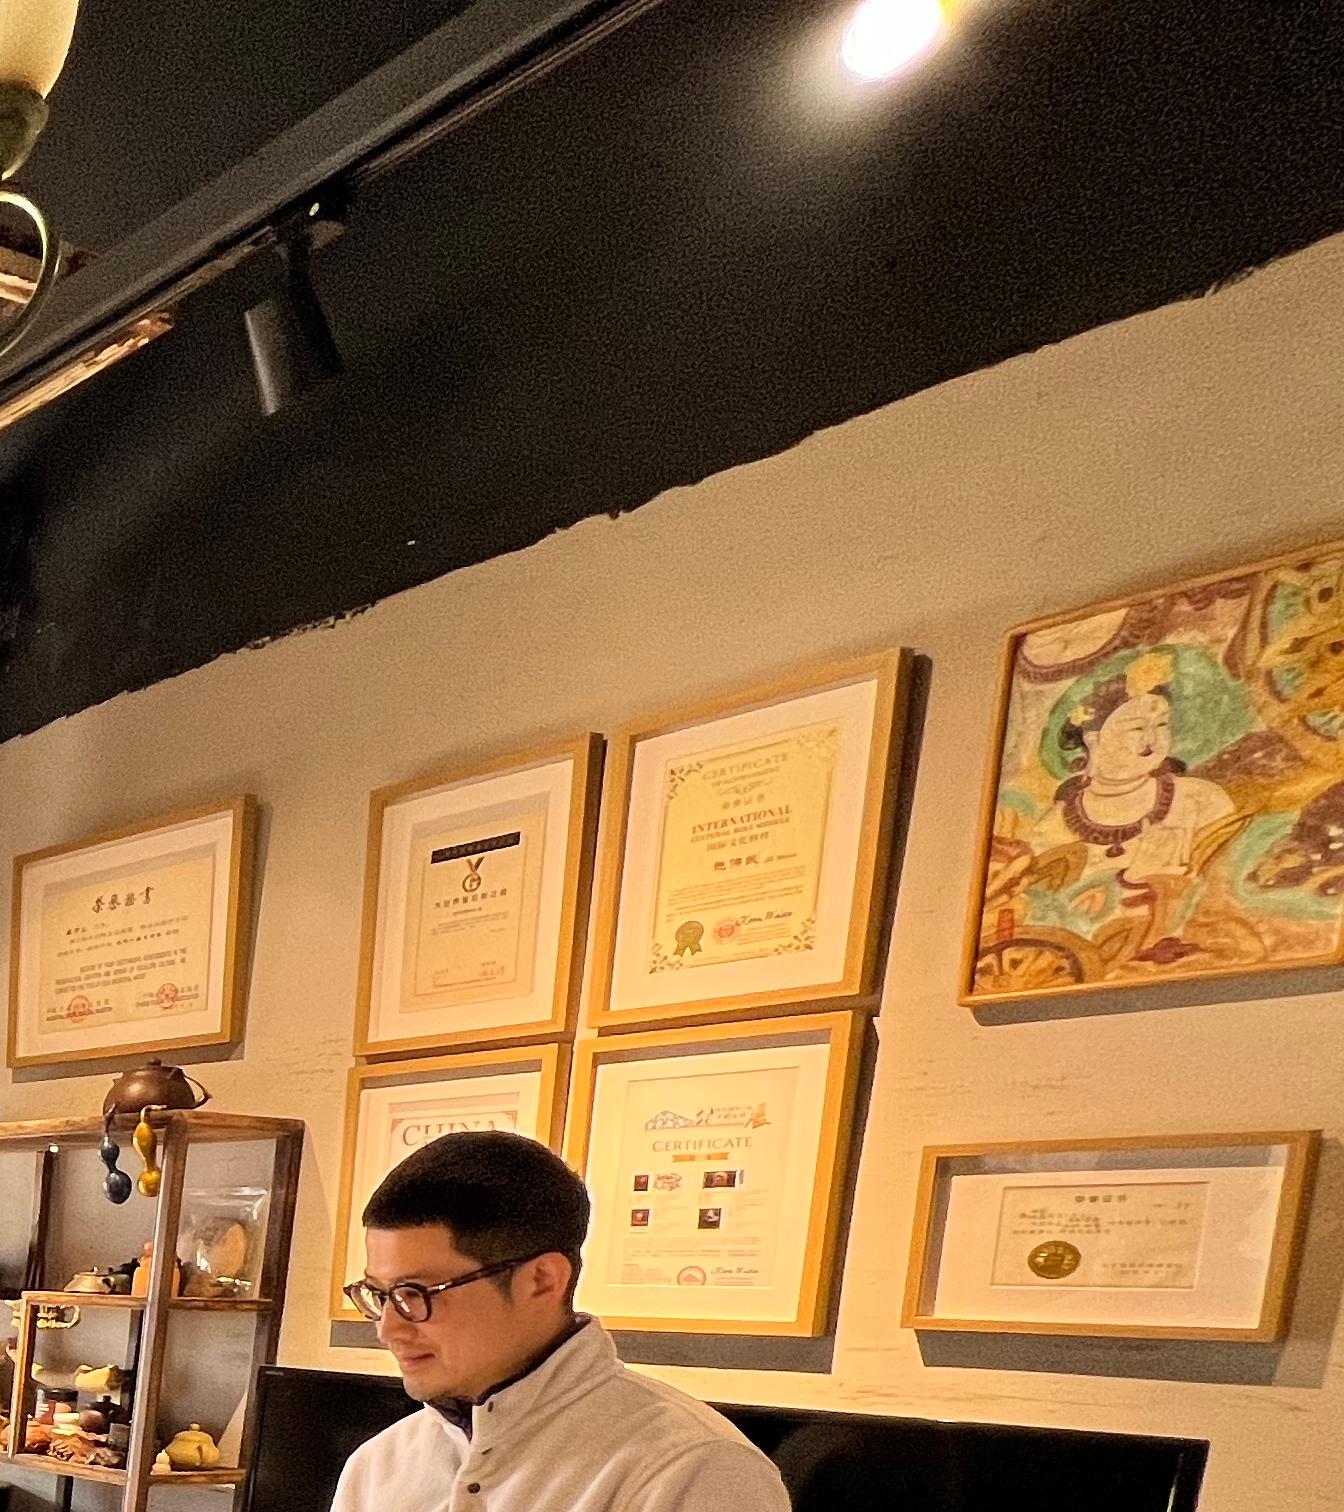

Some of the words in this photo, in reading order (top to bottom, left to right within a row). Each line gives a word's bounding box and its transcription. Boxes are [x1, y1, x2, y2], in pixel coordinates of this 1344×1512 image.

[702, 752, 789, 780] CERTIFICATE
[692, 804, 792, 834] INTERNATIONAL
[652, 1136, 752, 1152] CERTIFICATE
